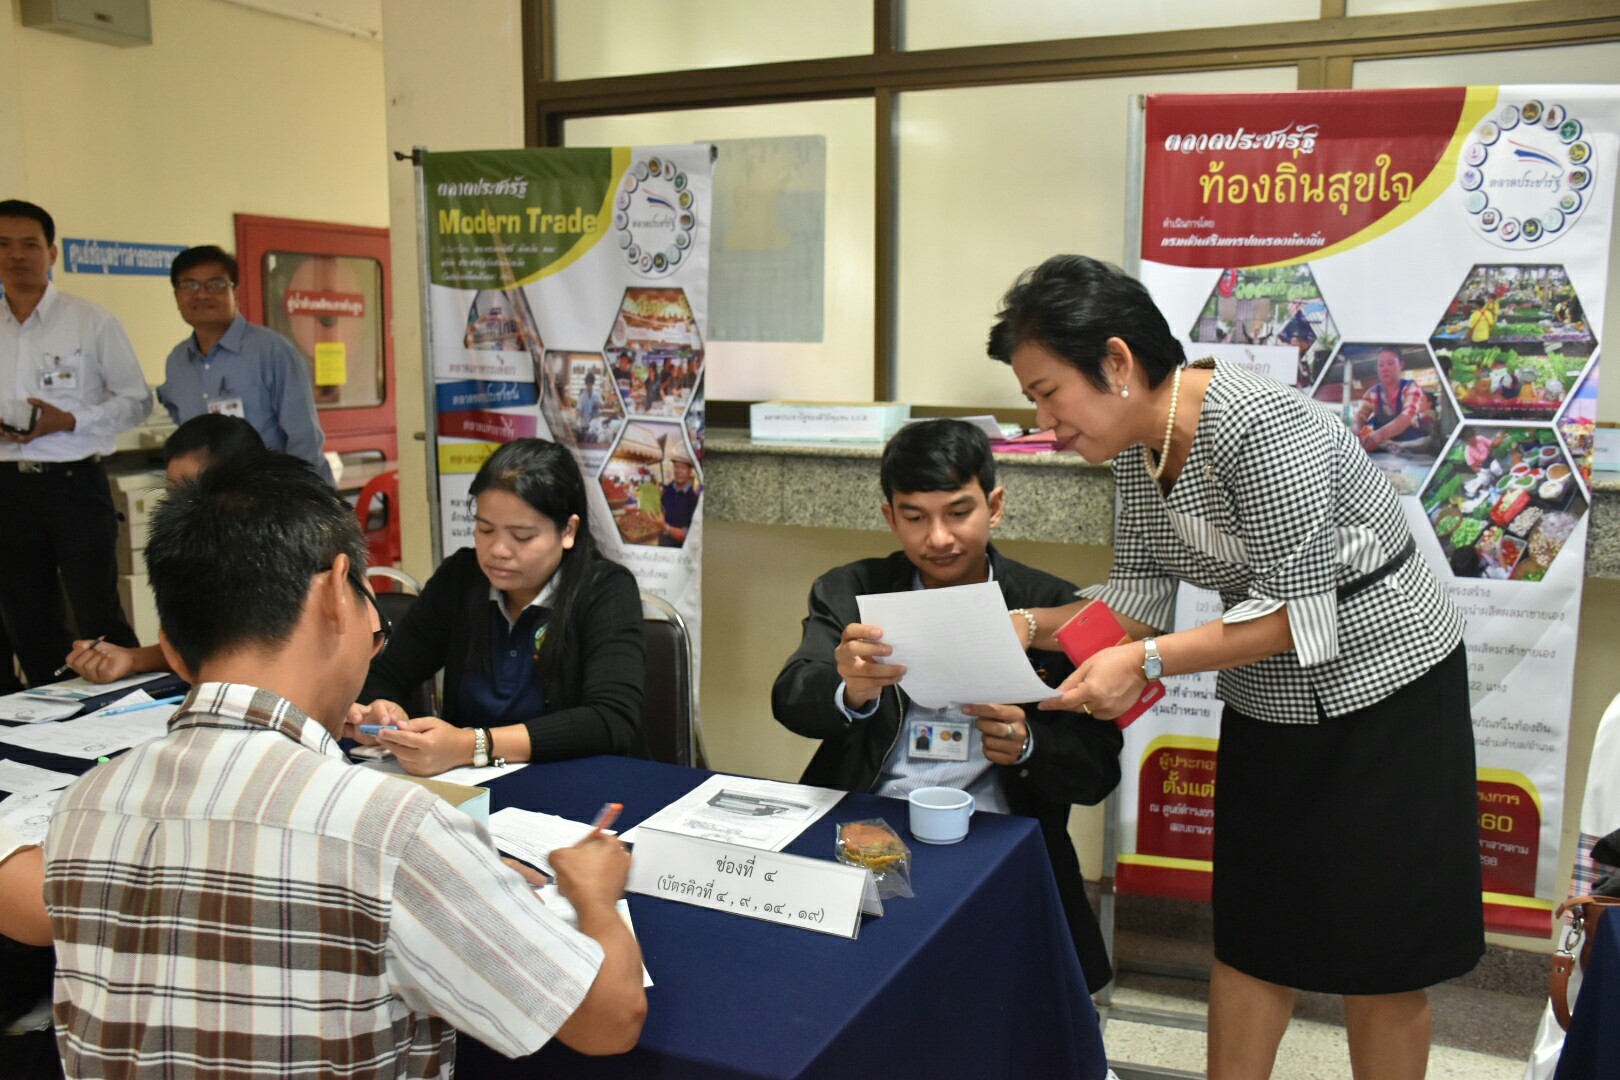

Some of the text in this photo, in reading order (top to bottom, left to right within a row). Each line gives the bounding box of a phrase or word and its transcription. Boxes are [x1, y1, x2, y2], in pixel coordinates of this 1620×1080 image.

[1164, 120, 1319, 154] ตลาดประชารัฐ
[1199, 149, 1414, 215] ท้องถิ่นสุขใจ
[1490, 170, 1563, 193] ตลาดประชารัฐ
[439, 206, 597, 235] Modern Trade
[1160, 752, 1216, 771] ผู้ประกอ
[1163, 770, 1215, 798] ตั้งแต่
[1478, 813, 1513, 832] 60
[716, 855, 778, 882] ช่องที่ ๔
[657, 874, 715, 899] (บัตรคิวที่
[763, 902, 786, 914] ๑๔
[798, 908, 825, 923] ๑๙)
